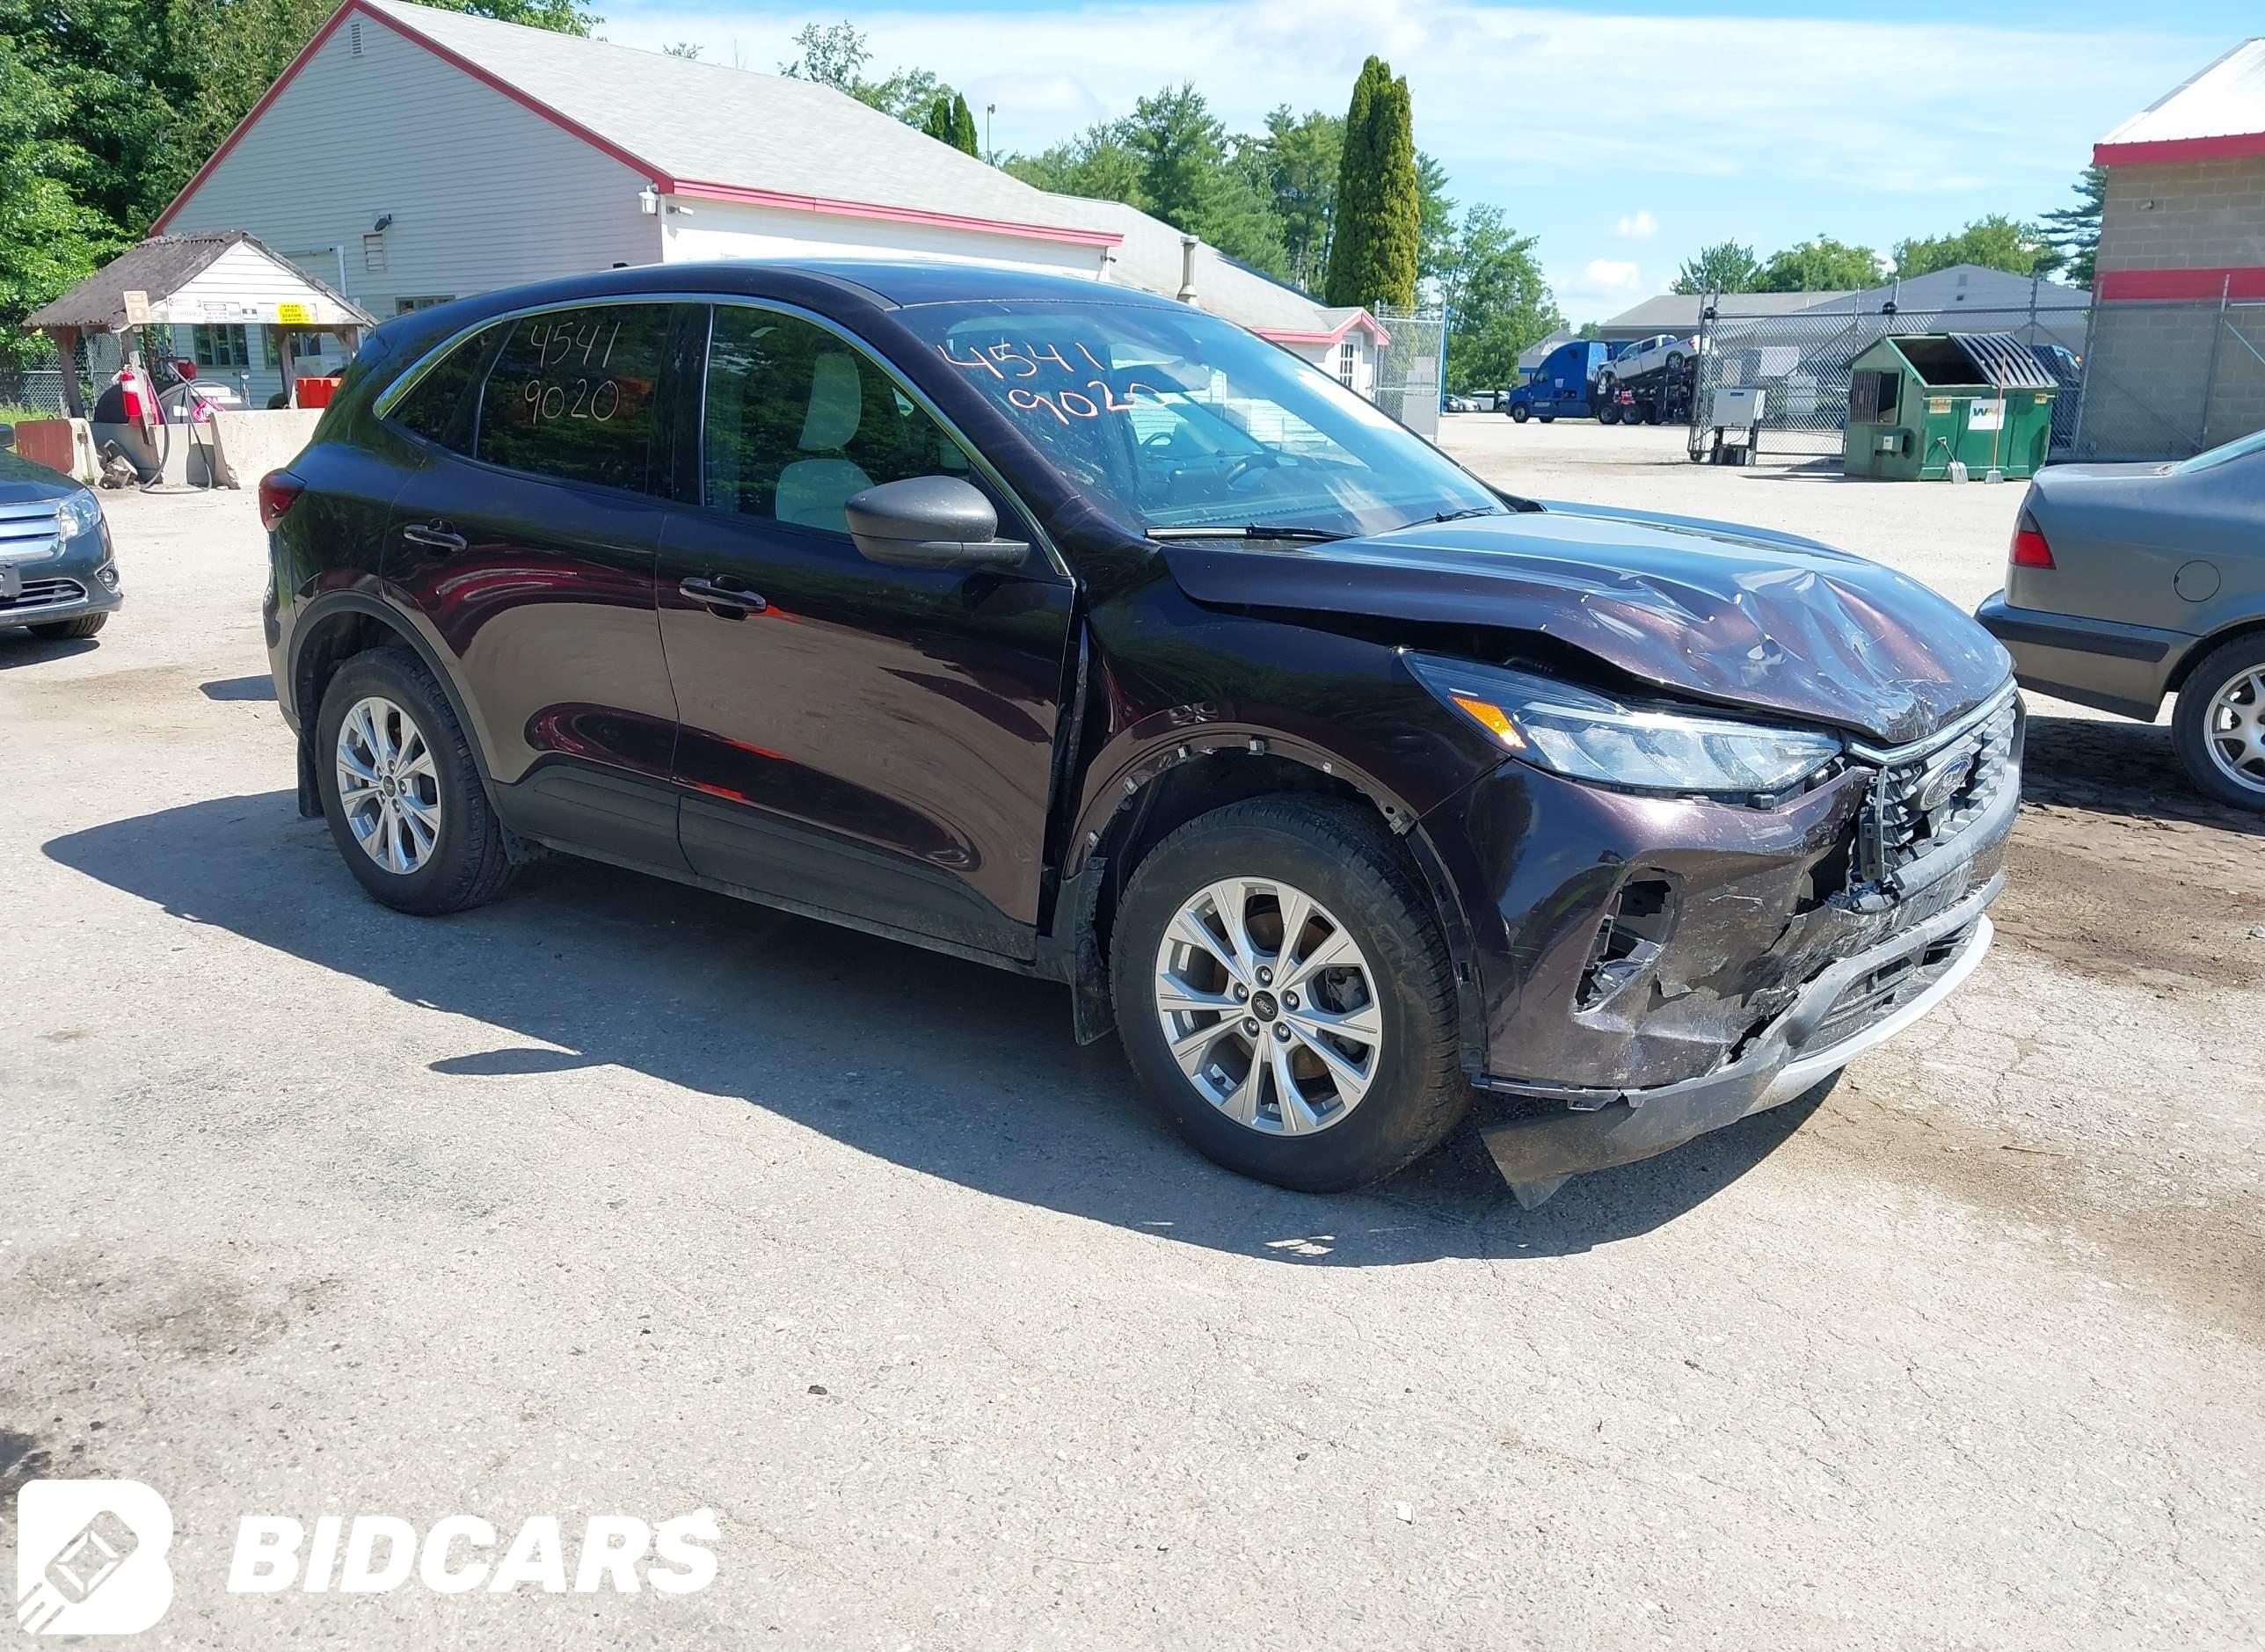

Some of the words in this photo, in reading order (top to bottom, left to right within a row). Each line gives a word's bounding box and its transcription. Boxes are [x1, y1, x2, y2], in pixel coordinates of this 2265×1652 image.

[530, 322, 621, 368] 4541
[936, 342, 1105, 379] 4541
[525, 379, 619, 425] 9020
[1009, 381, 1169, 426] 9020
